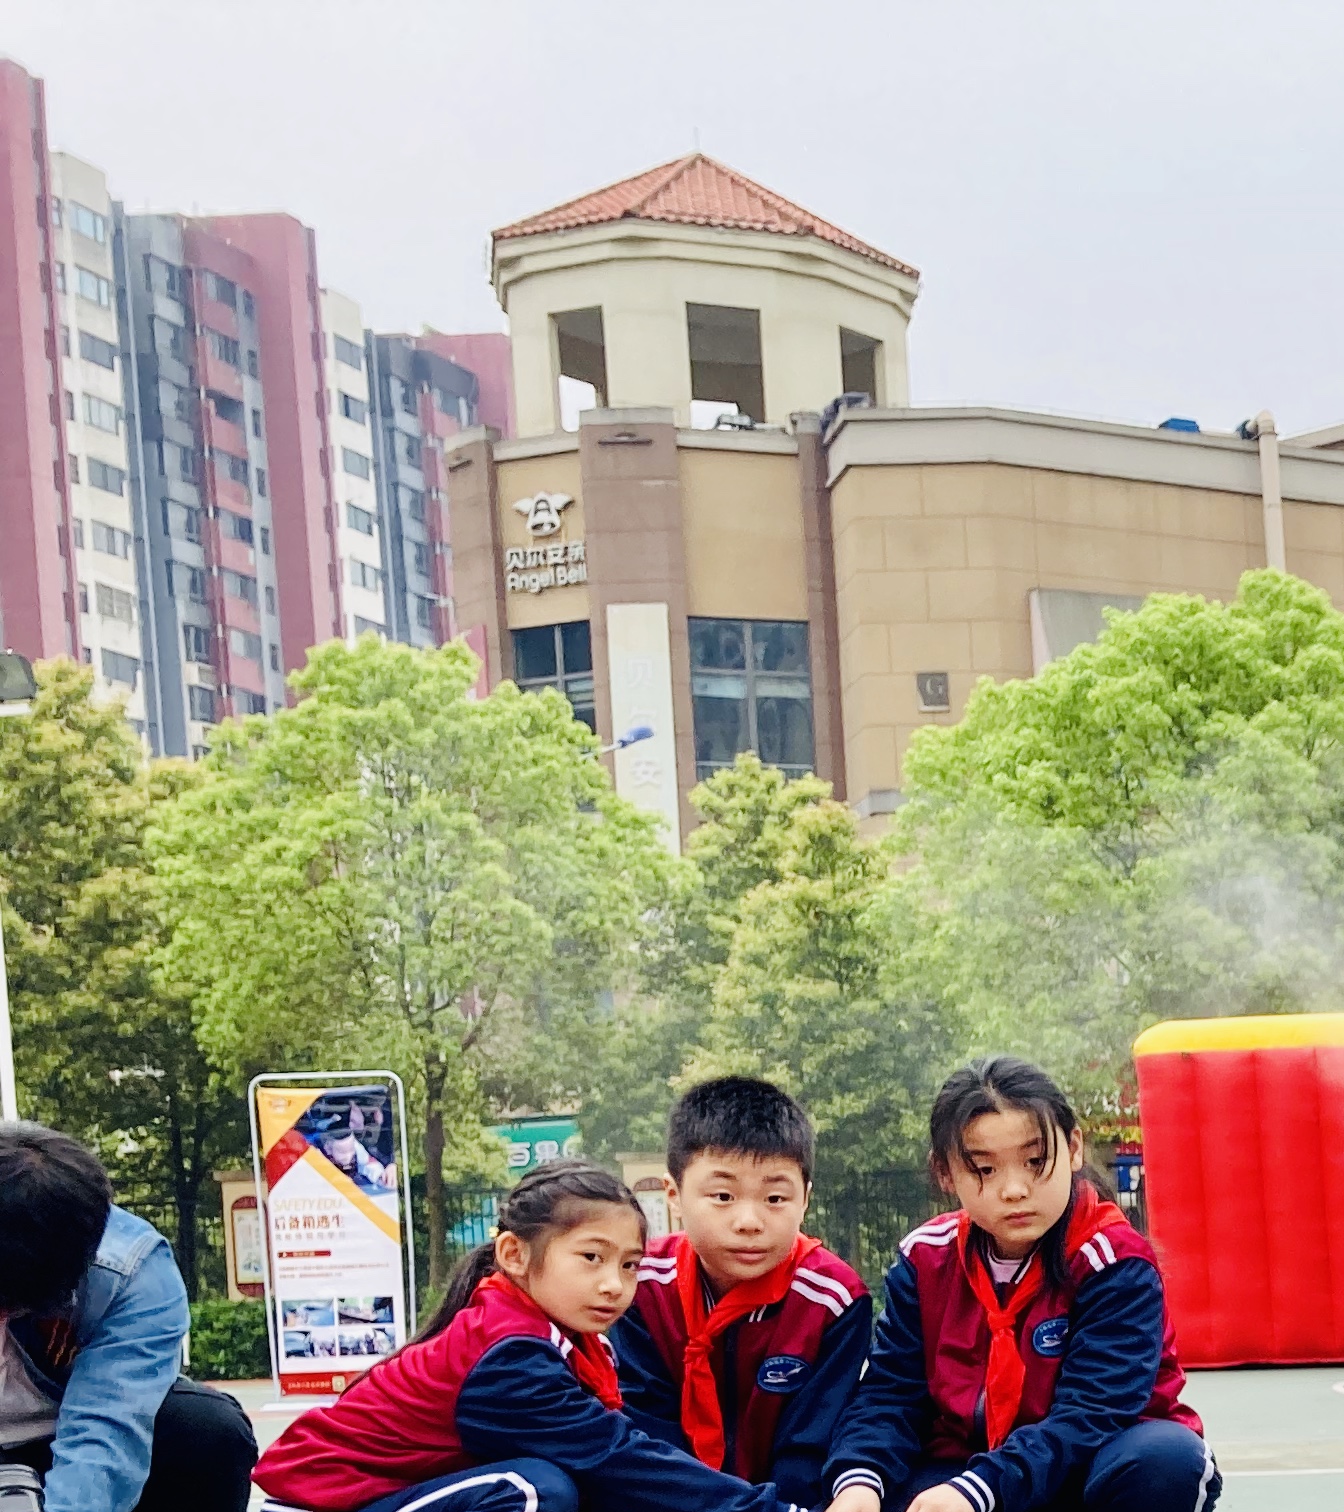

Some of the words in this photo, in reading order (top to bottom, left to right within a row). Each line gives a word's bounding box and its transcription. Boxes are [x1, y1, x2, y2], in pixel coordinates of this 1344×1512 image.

[507, 567, 554, 593] Angel
[556, 562, 587, 586] Bell
[274, 1198, 317, 1212] SAFETY
[317, 1198, 342, 1210] EDU
